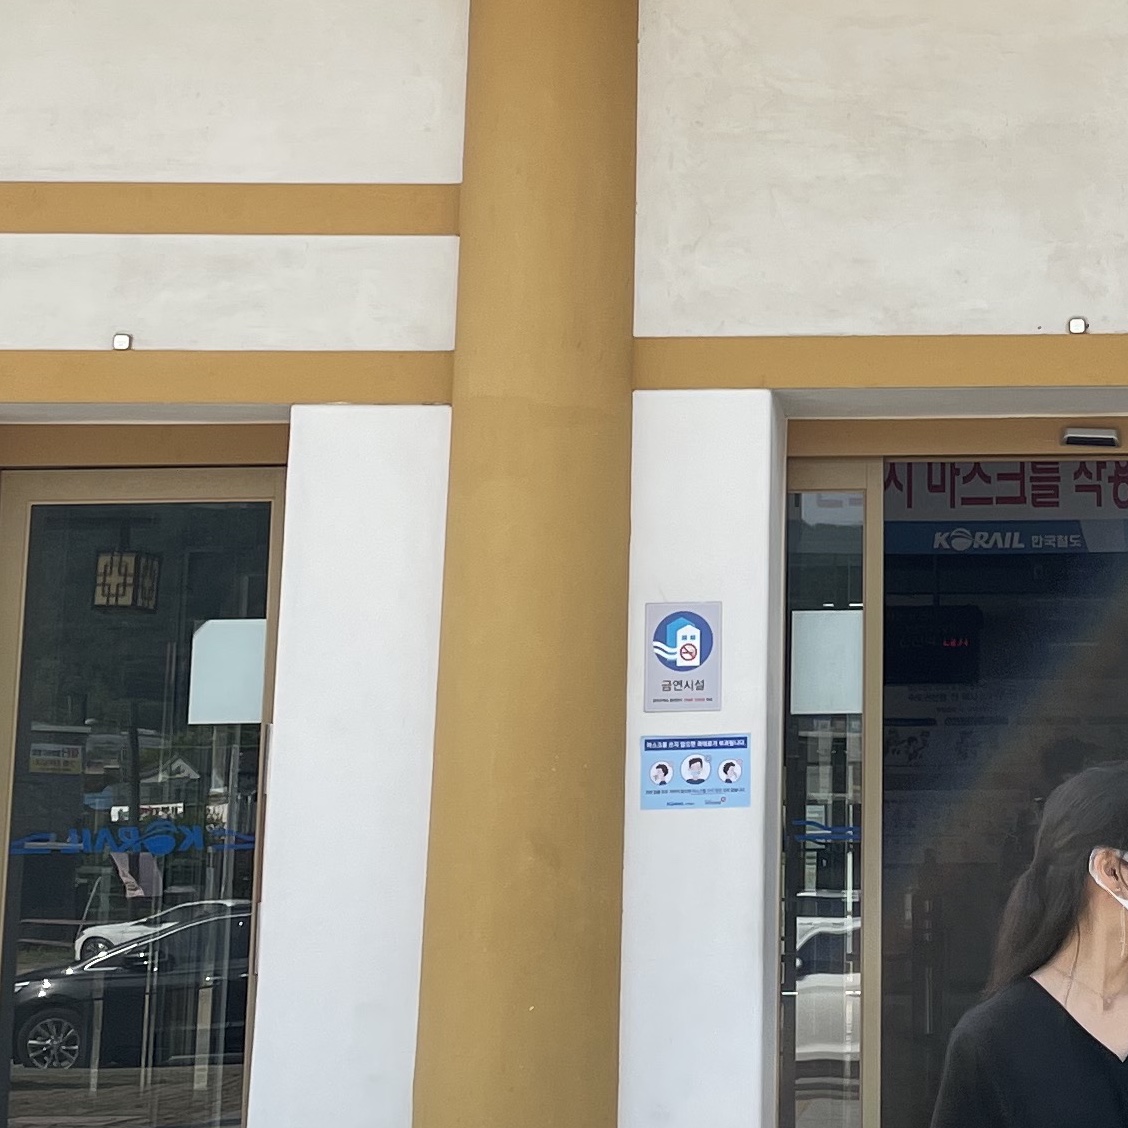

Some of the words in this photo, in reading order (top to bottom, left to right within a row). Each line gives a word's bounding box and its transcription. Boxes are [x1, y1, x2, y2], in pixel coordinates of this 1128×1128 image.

[927, 461, 1061, 509] 마스크를
[934, 528, 1026, 552] KORAIL
[661, 679, 705, 692] 금연시설
